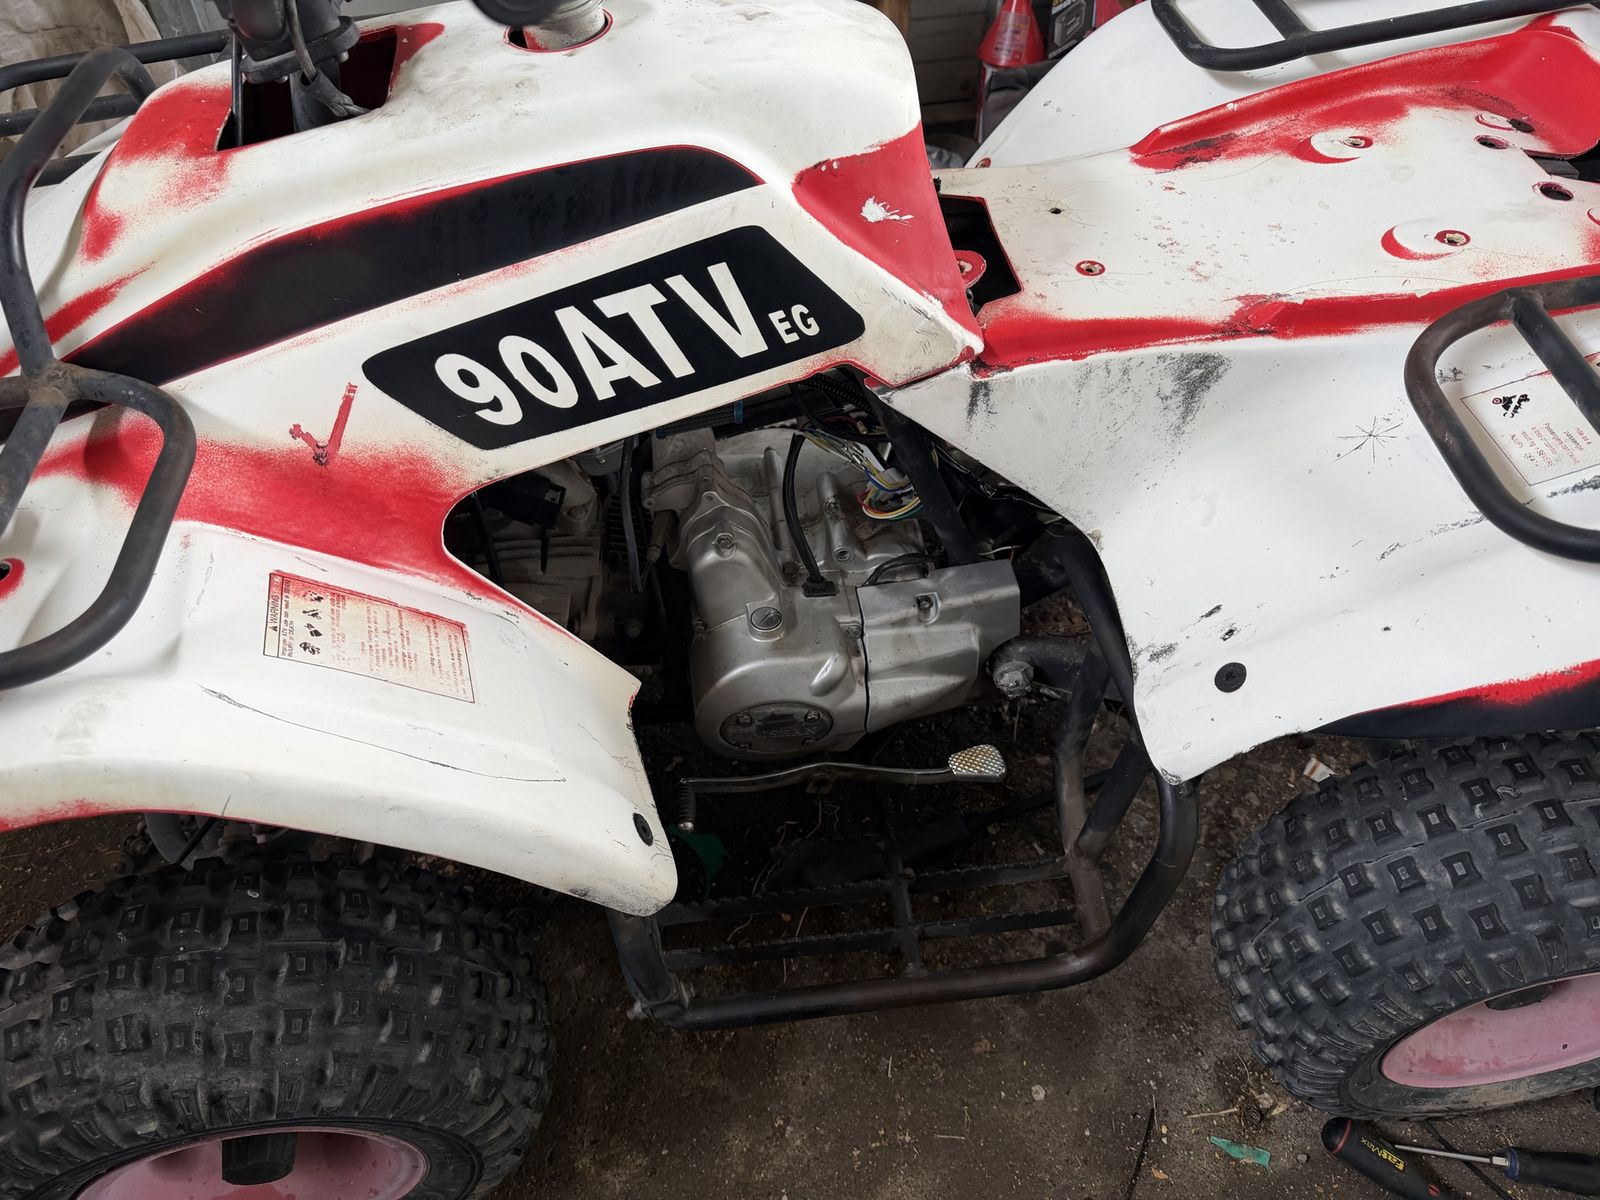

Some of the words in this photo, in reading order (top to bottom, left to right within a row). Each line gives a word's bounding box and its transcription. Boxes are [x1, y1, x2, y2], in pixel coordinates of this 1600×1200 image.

[434, 261, 769, 426] 90ATV
[768, 304, 820, 344] EG
[272, 594, 280, 624] WARNING
